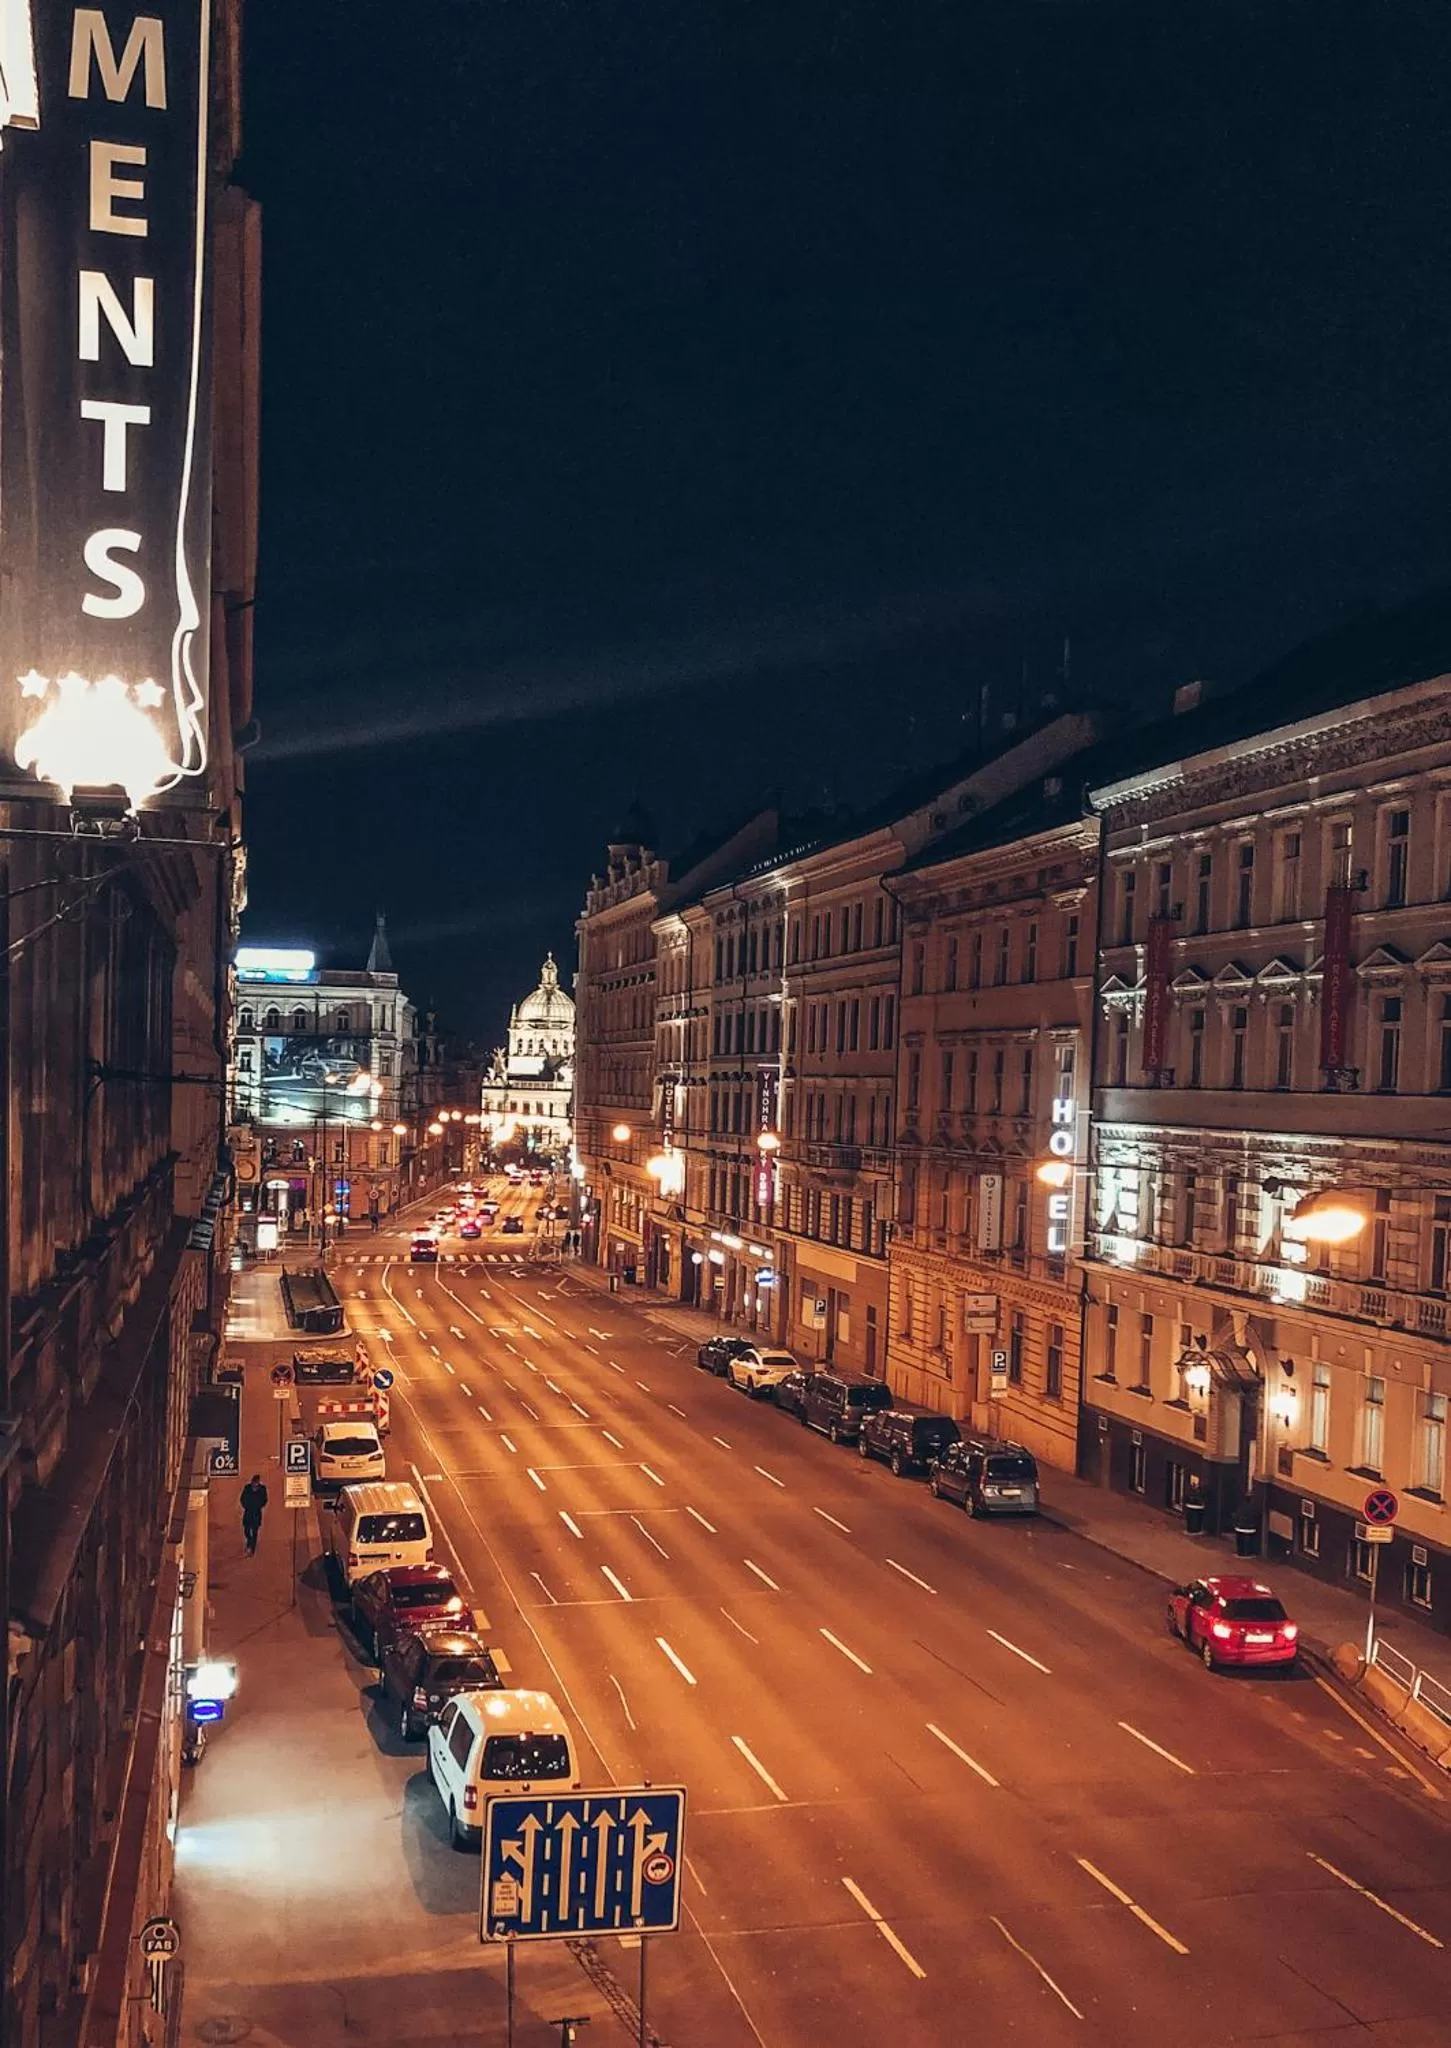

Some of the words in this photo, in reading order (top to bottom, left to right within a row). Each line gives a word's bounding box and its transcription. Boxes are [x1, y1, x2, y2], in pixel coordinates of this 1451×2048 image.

[68, 7, 168, 620] MENTS
[665, 1081, 674, 1119] HOTEL
[1048, 1099, 1074, 1251] HOEL
[994, 1352, 1005, 1368] P
[215, 1455, 234, 1469] 0%
[290, 1444, 305, 1465] P
[148, 1940, 172, 1951] FAB
